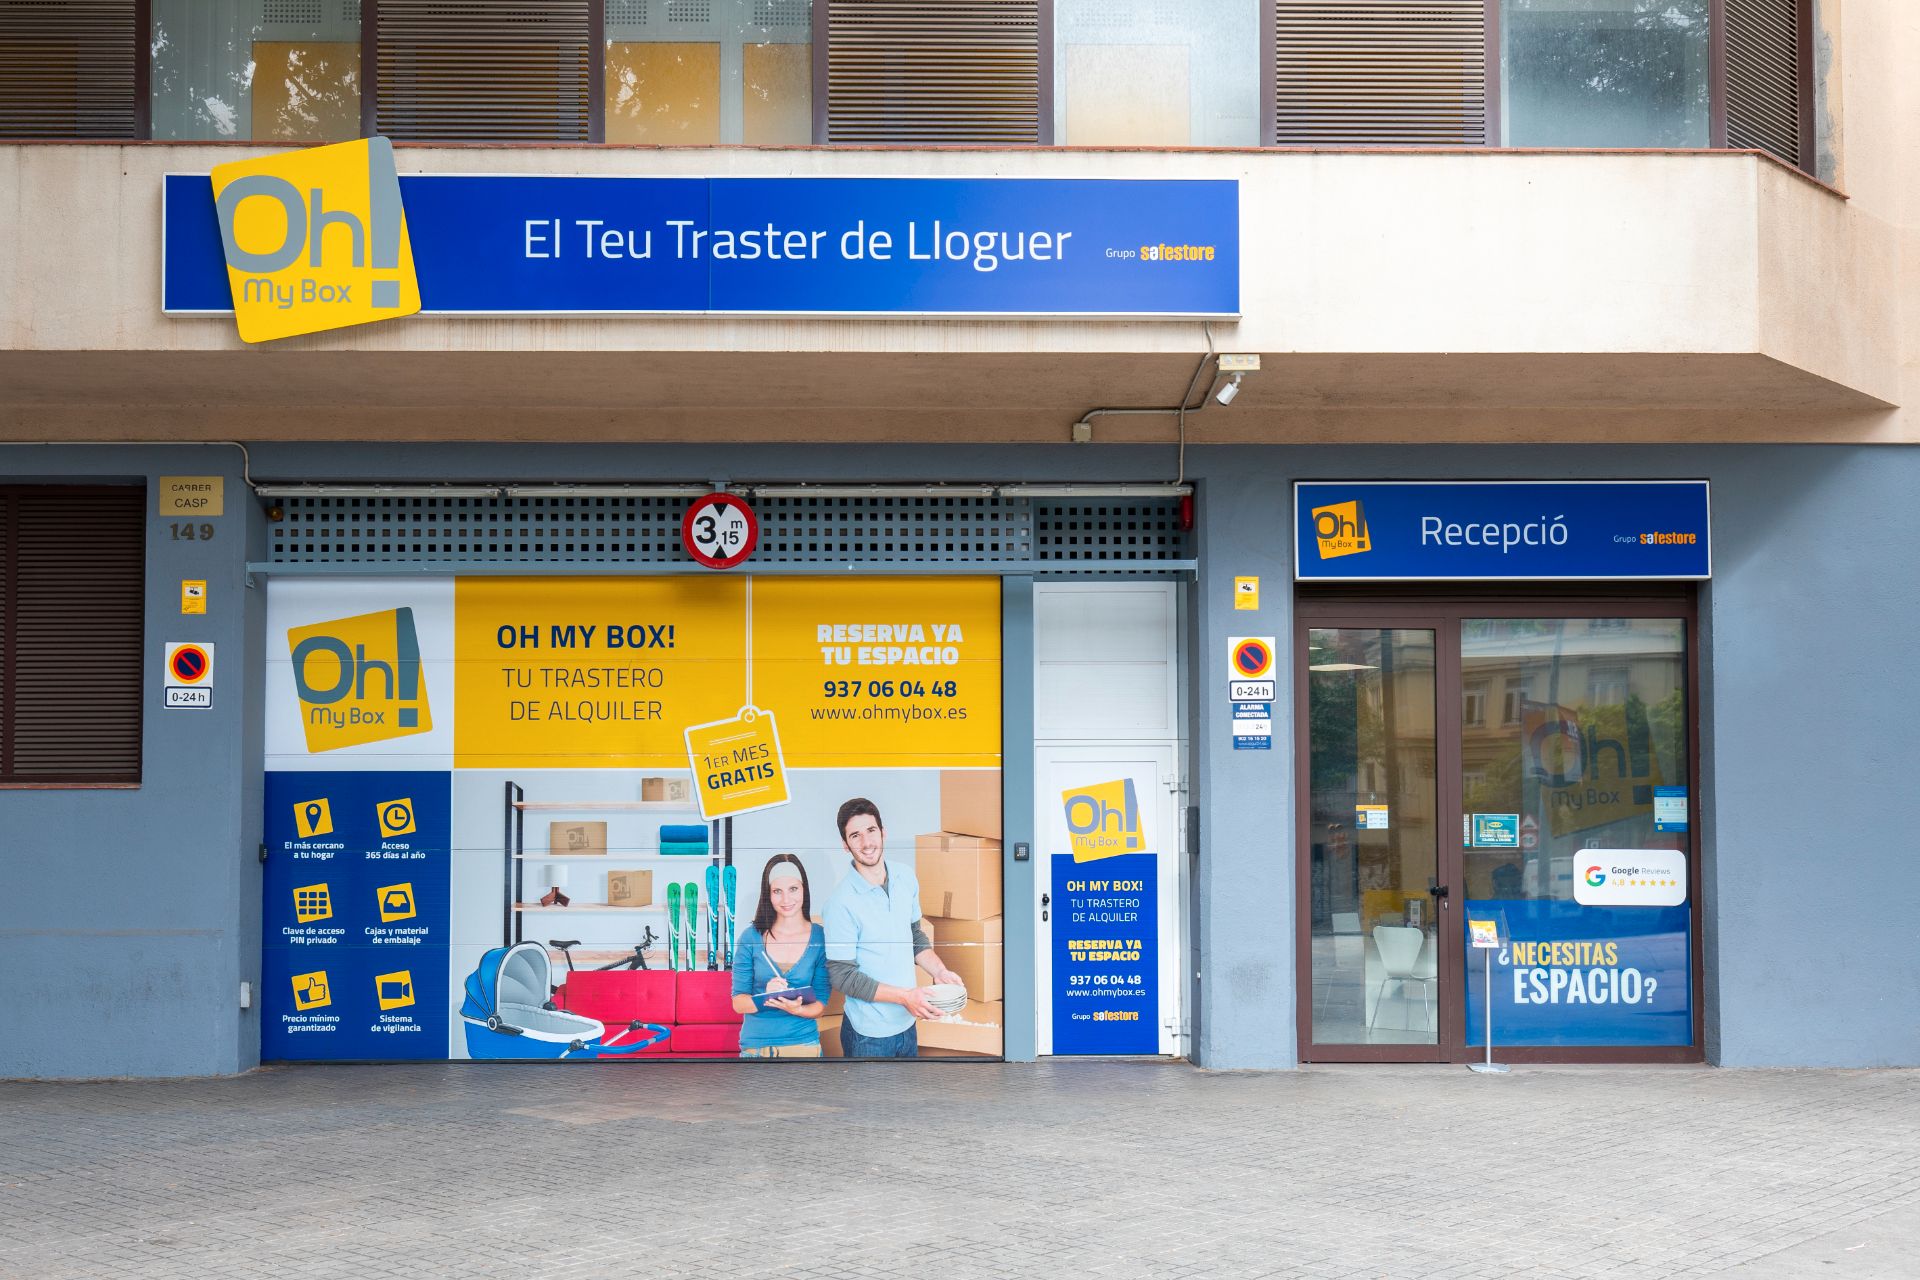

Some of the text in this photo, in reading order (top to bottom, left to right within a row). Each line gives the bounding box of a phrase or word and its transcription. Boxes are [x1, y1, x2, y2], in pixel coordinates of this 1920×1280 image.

[215, 136, 403, 308] Oh!
[525, 220, 1072, 272] El Teu Traster de Lloguer
[1105, 243, 1215, 261] Grupo safestore
[244, 279, 352, 309] My Box
[174, 498, 208, 508] CASP
[1315, 500, 1366, 548] Oh!
[170, 523, 214, 540] 149
[1422, 514, 1568, 553] Recepció
[1613, 531, 1696, 544] Grupo safestore
[1322, 540, 1352, 549] My Box
[497, 624, 675, 649] OH MY BOX!
[817, 624, 964, 643] RESERVA YA
[821, 646, 959, 665] TU ESPACIO
[291, 606, 420, 727] Oh!
[502, 668, 664, 688] TU TRASTERO
[823, 680, 957, 698] 937 06 04 48
[1236, 687, 1269, 696] 0-24 h
[172, 692, 205, 702] 0-24 h
[311, 707, 385, 728] My Box
[511, 701, 662, 724] DE ALQUILER
[810, 704, 967, 723] www.ohmybox.es
[703, 743, 769, 769] 1ER MES
[707, 762, 775, 790] GRATIS
[1551, 789, 1621, 809] My Box
[1064, 778, 1138, 848] Oh!
[284, 841, 293, 849] El
[294, 841, 312, 849] más
[1075, 836, 1119, 848] My Box
[300, 851, 310, 859] tu
[311, 851, 335, 860] hogar
[383, 851, 400, 859] días
[401, 851, 409, 859] al
[1612, 867, 1639, 876] Google
[1066, 881, 1143, 892] OH MY BOX!
[1071, 898, 1140, 908] TU TRASTERO
[1072, 912, 1138, 923] DE ALQUILER
[282, 927, 305, 935] Clave
[306, 927, 317, 935] de
[364, 927, 429, 937] Cajas y material
[290, 936, 337, 945] PIN privado
[372, 936, 421, 945] de embalaje
[1068, 940, 1142, 950] RESERVA YA
[1070, 951, 1140, 961] TU ESPACIO
[1070, 975, 1142, 985] 937 06 04 48
[1514, 968, 1658, 1004] ESPACIO?
[1066, 988, 1146, 998] www.ohmybox.es
[282, 1015, 340, 1023] Precio mínimo
[379, 1015, 413, 1023] Sistema
[1071, 1010, 1139, 1021] Grupo safestore
[287, 1024, 336, 1034] garantizado
[371, 1024, 421, 1034] de vigilancia
